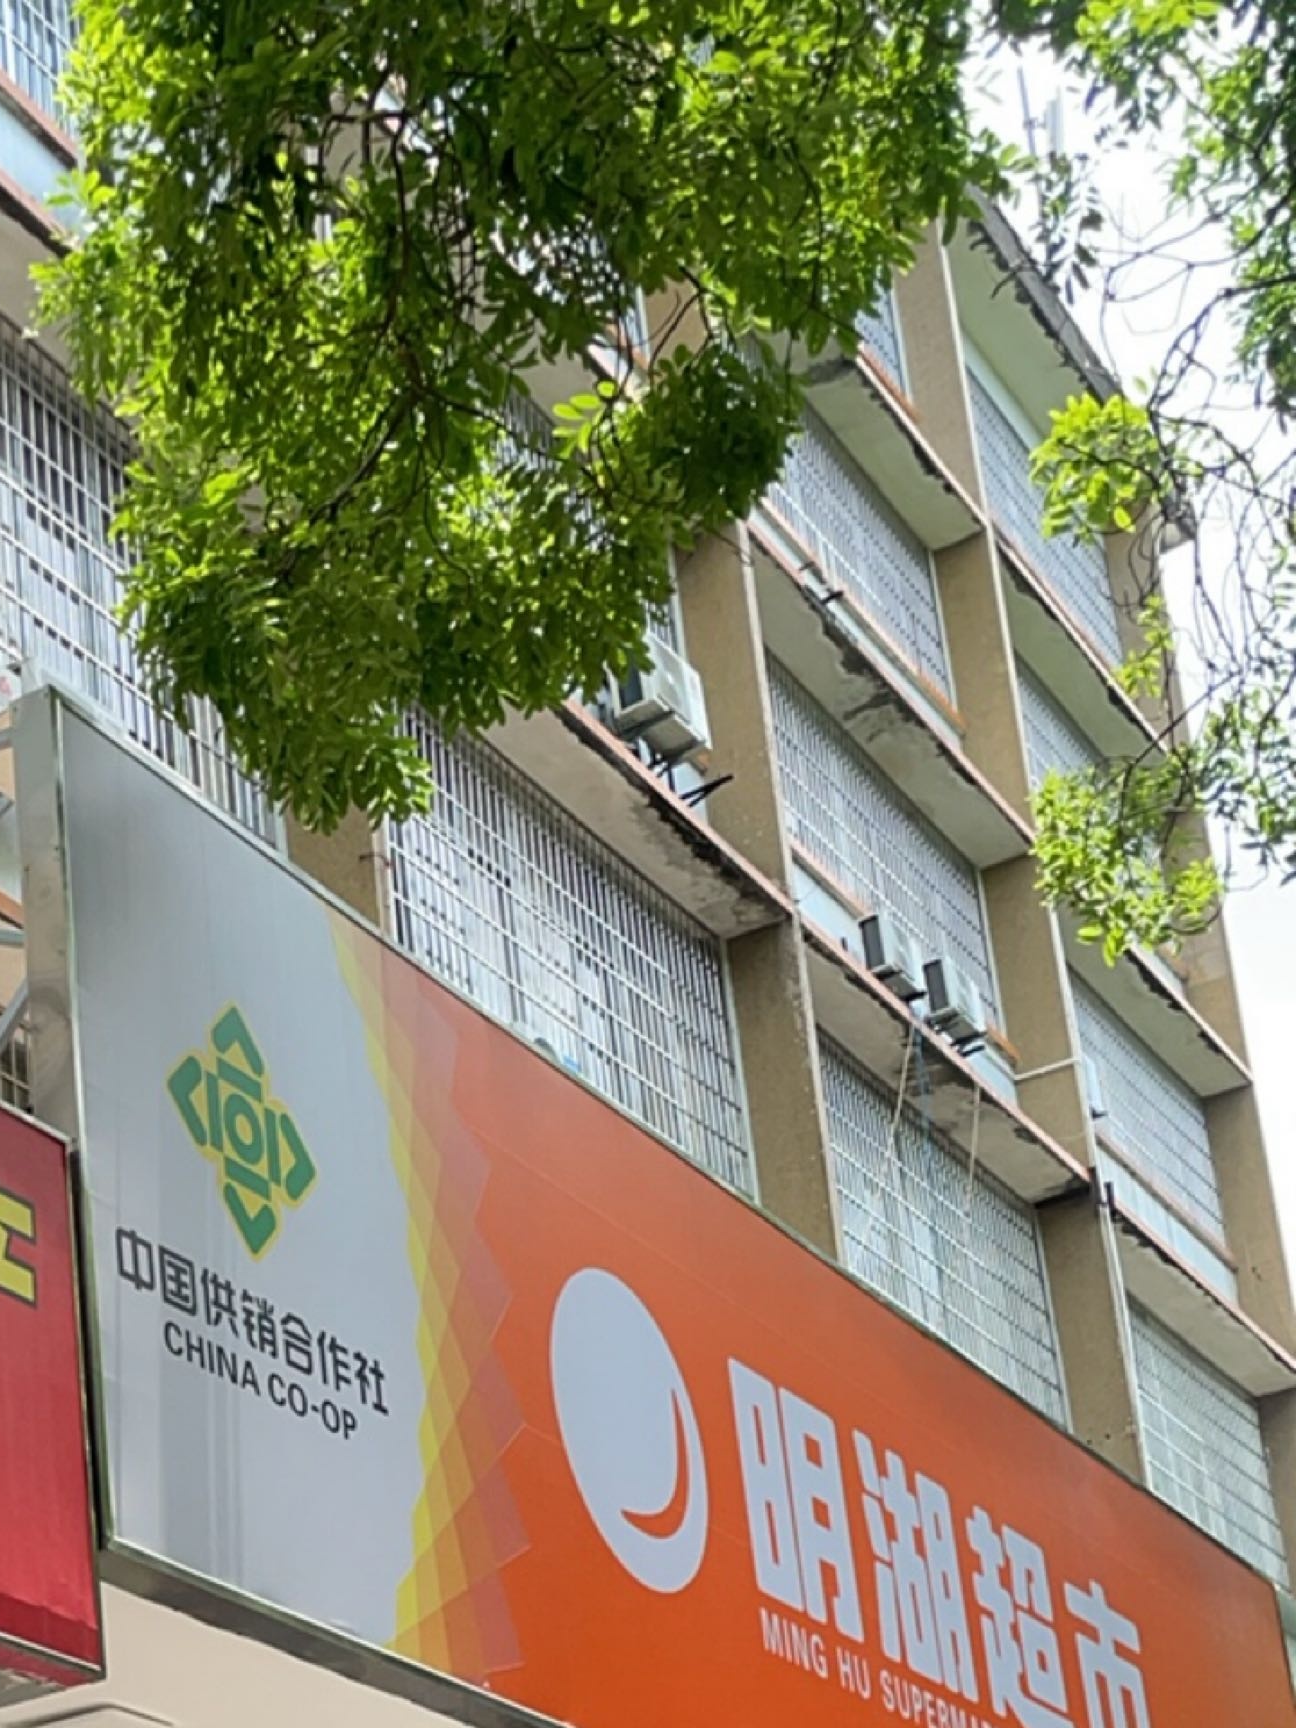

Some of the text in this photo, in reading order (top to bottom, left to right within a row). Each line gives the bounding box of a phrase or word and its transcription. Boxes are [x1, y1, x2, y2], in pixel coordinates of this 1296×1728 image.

[115, 1226, 391, 1416] 中国供销合作社
[163, 1320, 359, 1441] CHINA CO-OP
[759, 1606, 829, 1680] MING
[836, 1646, 872, 1700] HU
